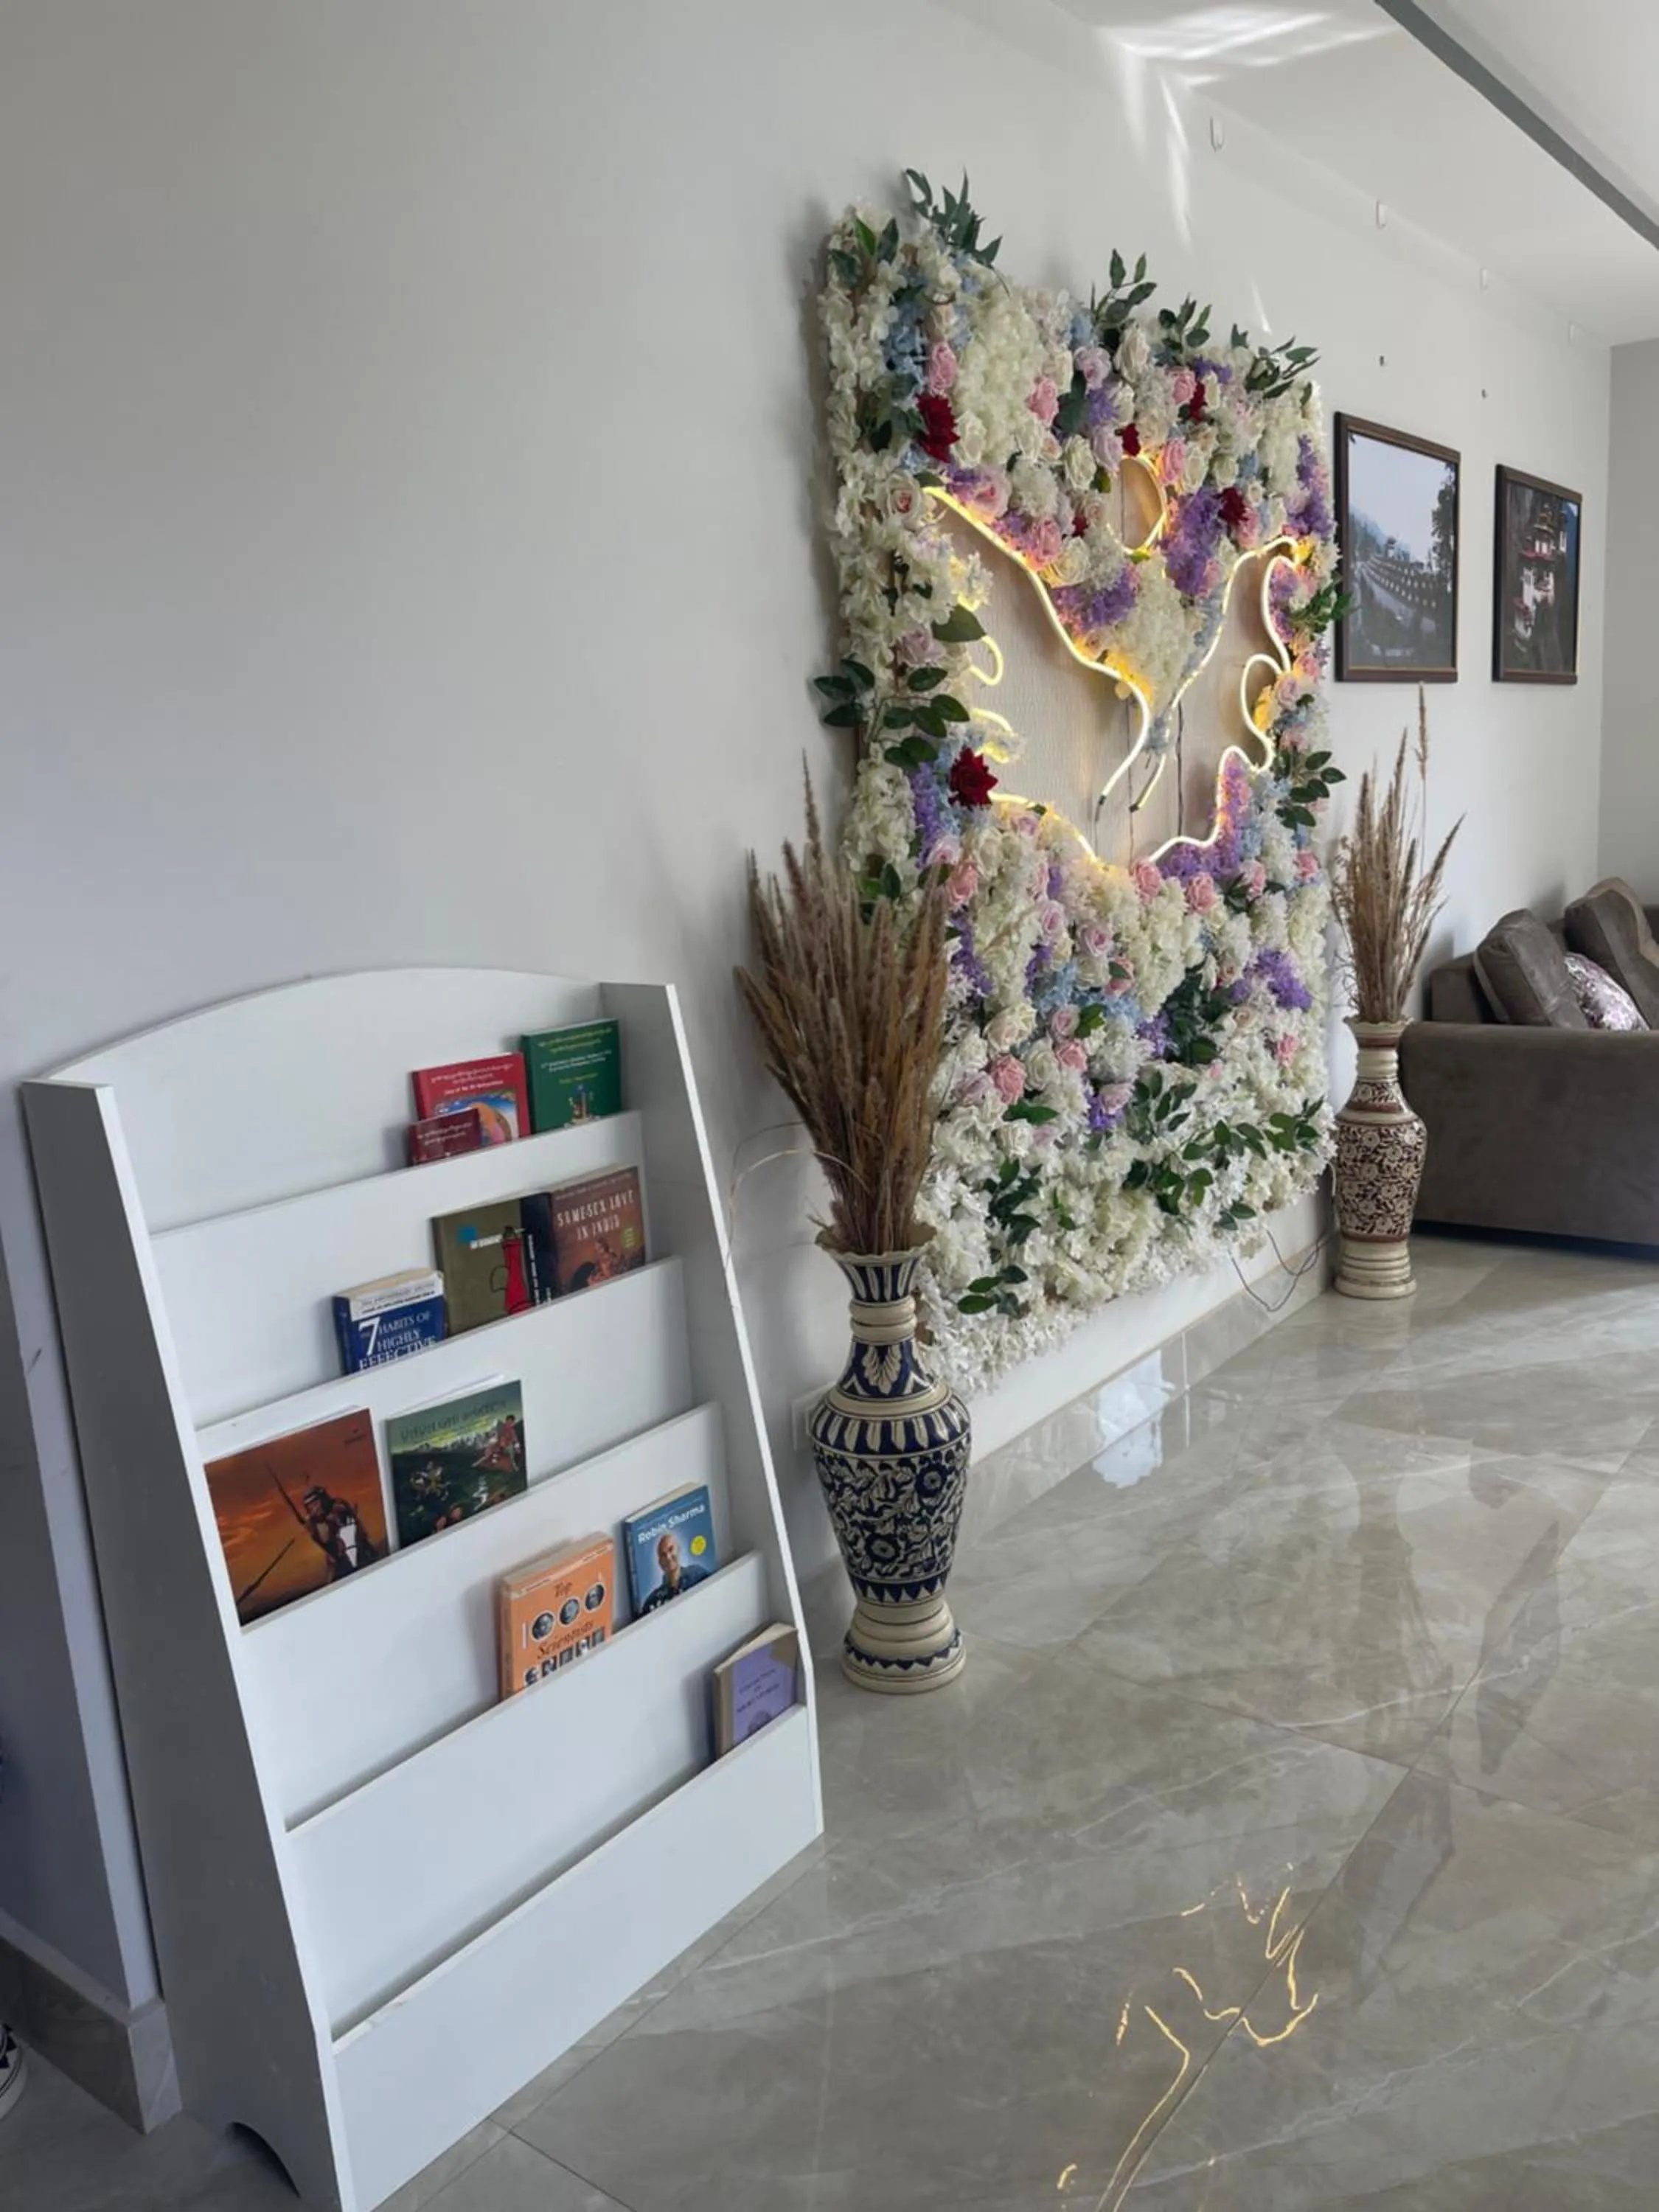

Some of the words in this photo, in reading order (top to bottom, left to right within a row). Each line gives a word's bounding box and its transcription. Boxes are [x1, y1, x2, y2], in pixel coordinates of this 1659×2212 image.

[609, 1189, 633, 1210] LOVE
[577, 1225, 589, 1241] IN
[592, 1214, 619, 1237] INDIA
[358, 1316, 380, 1357] 7
[378, 1316, 414, 1335] HABITS
[416, 1311, 431, 1323] OF
[377, 1329, 420, 1352] HIGHLY
[637, 1523, 668, 1545] Robin
[668, 1504, 706, 1529] Sharma
